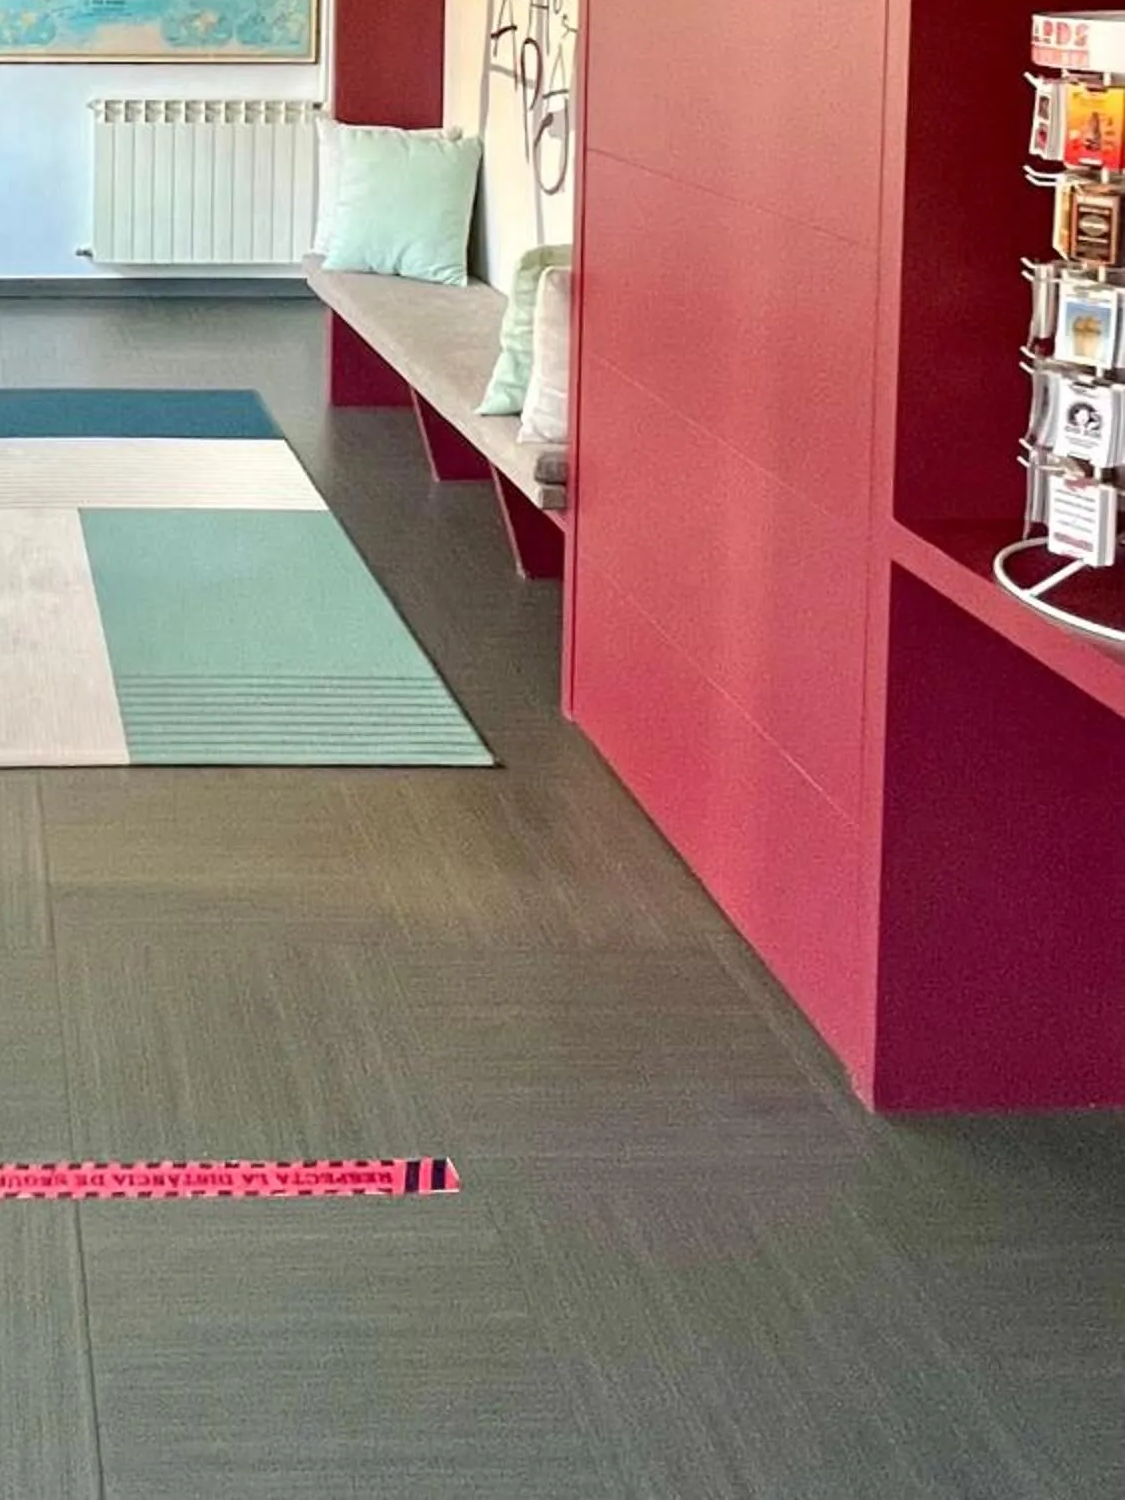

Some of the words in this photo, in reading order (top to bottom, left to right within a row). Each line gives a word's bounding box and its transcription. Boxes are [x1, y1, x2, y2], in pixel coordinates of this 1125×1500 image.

[76, 1174, 105, 1186] DE
[241, 1173, 270, 1185] LA
[276, 1171, 394, 1185] RESPECTA
